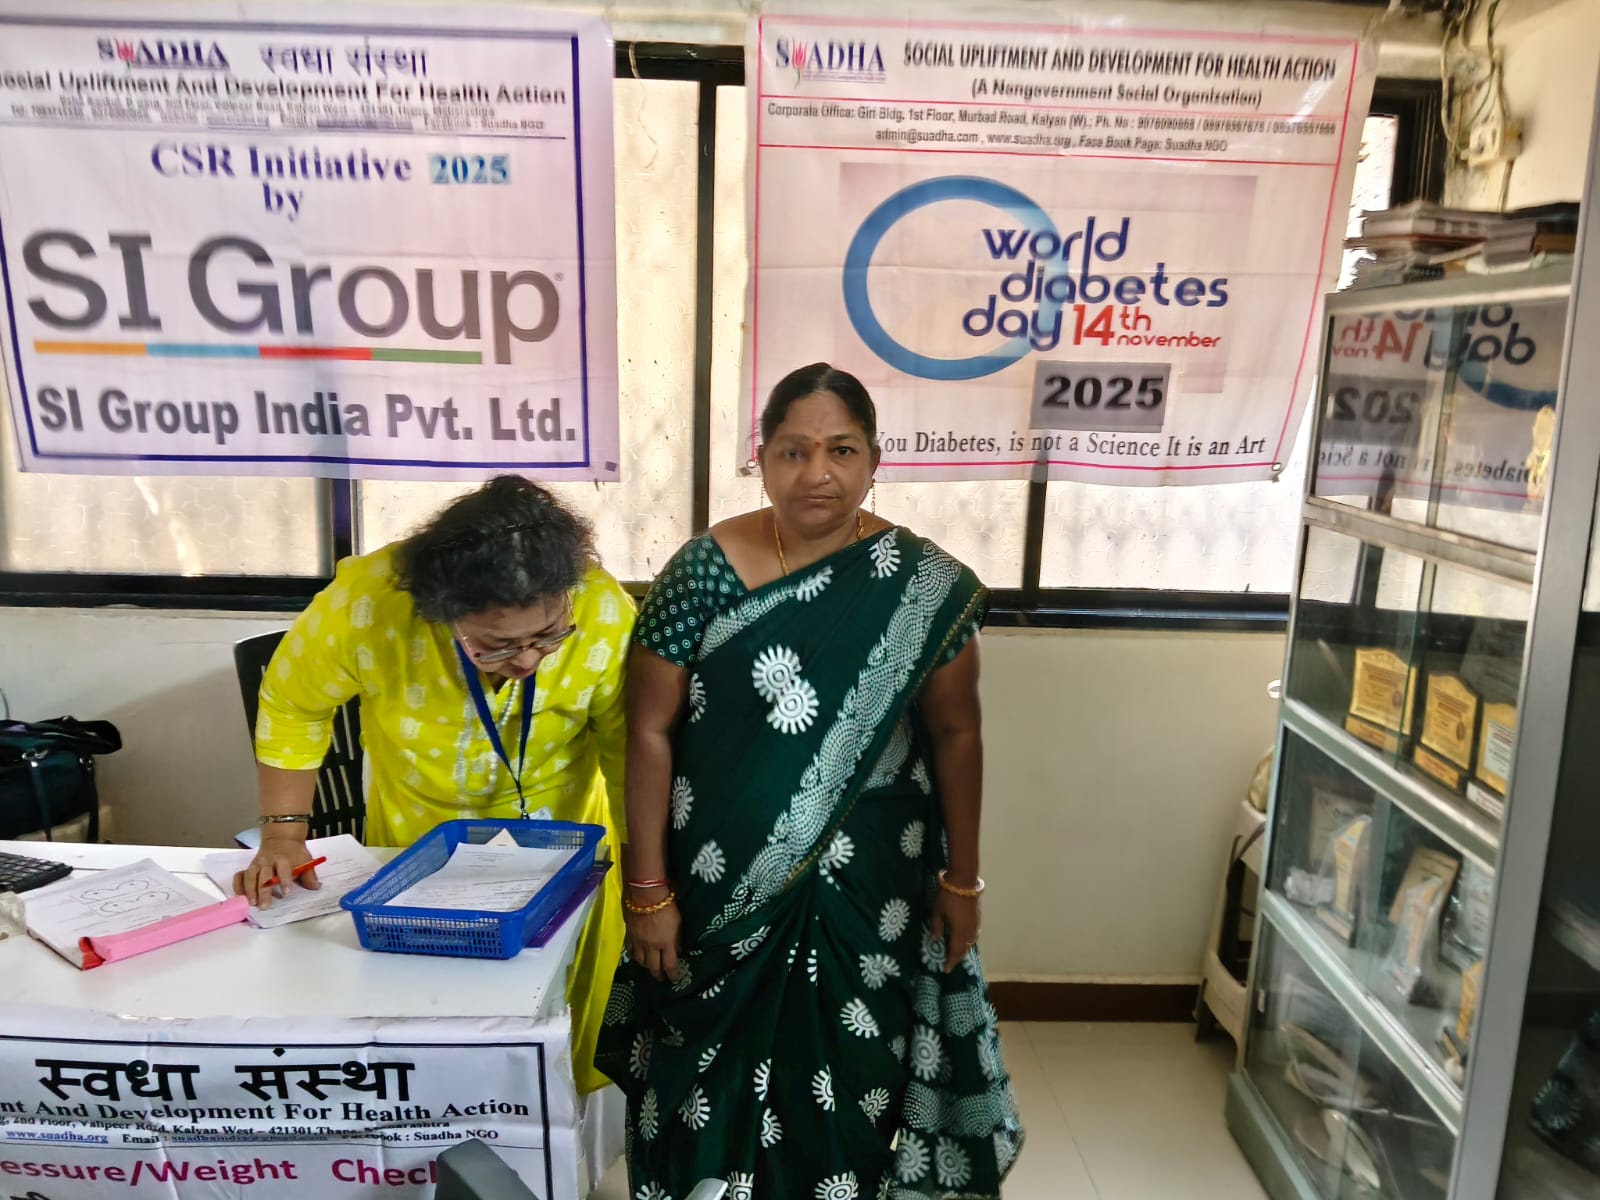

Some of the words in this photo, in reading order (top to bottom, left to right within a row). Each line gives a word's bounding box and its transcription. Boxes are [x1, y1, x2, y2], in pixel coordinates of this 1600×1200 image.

[904, 40, 954, 67] SOCIAL
[960, 42, 1047, 71] UPLIFTMENT
[1052, 48, 1085, 71] AND
[1088, 49, 1192, 76] DEVELOPMENT
[1195, 52, 1223, 78] FOR
[1227, 54, 1280, 80] HEALTH
[1282, 57, 1336, 80] ACTION
[0, 71, 51, 92] ocial
[59, 71, 169, 96] Upliftment
[176, 73, 218, 94] And
[225, 75, 368, 101] Development
[376, 80, 410, 100] For
[418, 81, 490, 103] Health
[496, 83, 567, 104] Action
[972, 79, 988, 97] (A
[993, 80, 1112, 102] Nongovernment
[1116, 84, 1159, 102] Social
[768, 103, 818, 118] Corporate
[909, 107, 924, 121] 1st
[1032, 112, 1067, 128] Kalyan
[151, 143, 234, 178] CSR
[249, 145, 412, 182] Initiative
[430, 154, 509, 184] 2025
[264, 183, 304, 221] by
[982, 217, 1130, 261] world
[23, 229, 162, 332] SI
[188, 236, 560, 364] Group
[1001, 261, 1228, 308] diabetes
[962, 295, 1063, 351] day
[1117, 332, 1222, 348] november
[1042, 375, 1165, 410] 2025
[38, 388, 83, 434] SI
[100, 389, 240, 445] Group
[255, 391, 371, 437] India
[386, 393, 473, 441] Pvt.
[490, 397, 577, 442] Ltd.
[914, 431, 1001, 456] Diabetes,
[1009, 432, 1024, 453] is
[1031, 434, 1064, 452] not
[1068, 438, 1079, 453] a
[1087, 433, 1160, 457] Science
[1166, 435, 1183, 456] It
[1187, 436, 1201, 455] is
[1208, 441, 1229, 456] an
[1235, 435, 1266, 455] Art
[35, 1058, 200, 1101] स्वधा
[235, 1048, 415, 1102] संस्था
[36, 1101, 89, 1117] And
[97, 1103, 275, 1124] Development
[283, 1104, 332, 1120] For
[341, 1102, 432, 1121] Health
[441, 1099, 530, 1117] Action
[6, 1130, 109, 1144] www.suadha.org
[122, 1133, 160, 1144] Email
[413, 1131, 462, 1142] Suadha
[465, 1129, 499, 1140] NGO
[173, 1124, 219, 1137] Kalyan
[221, 1125, 254, 1136] West
